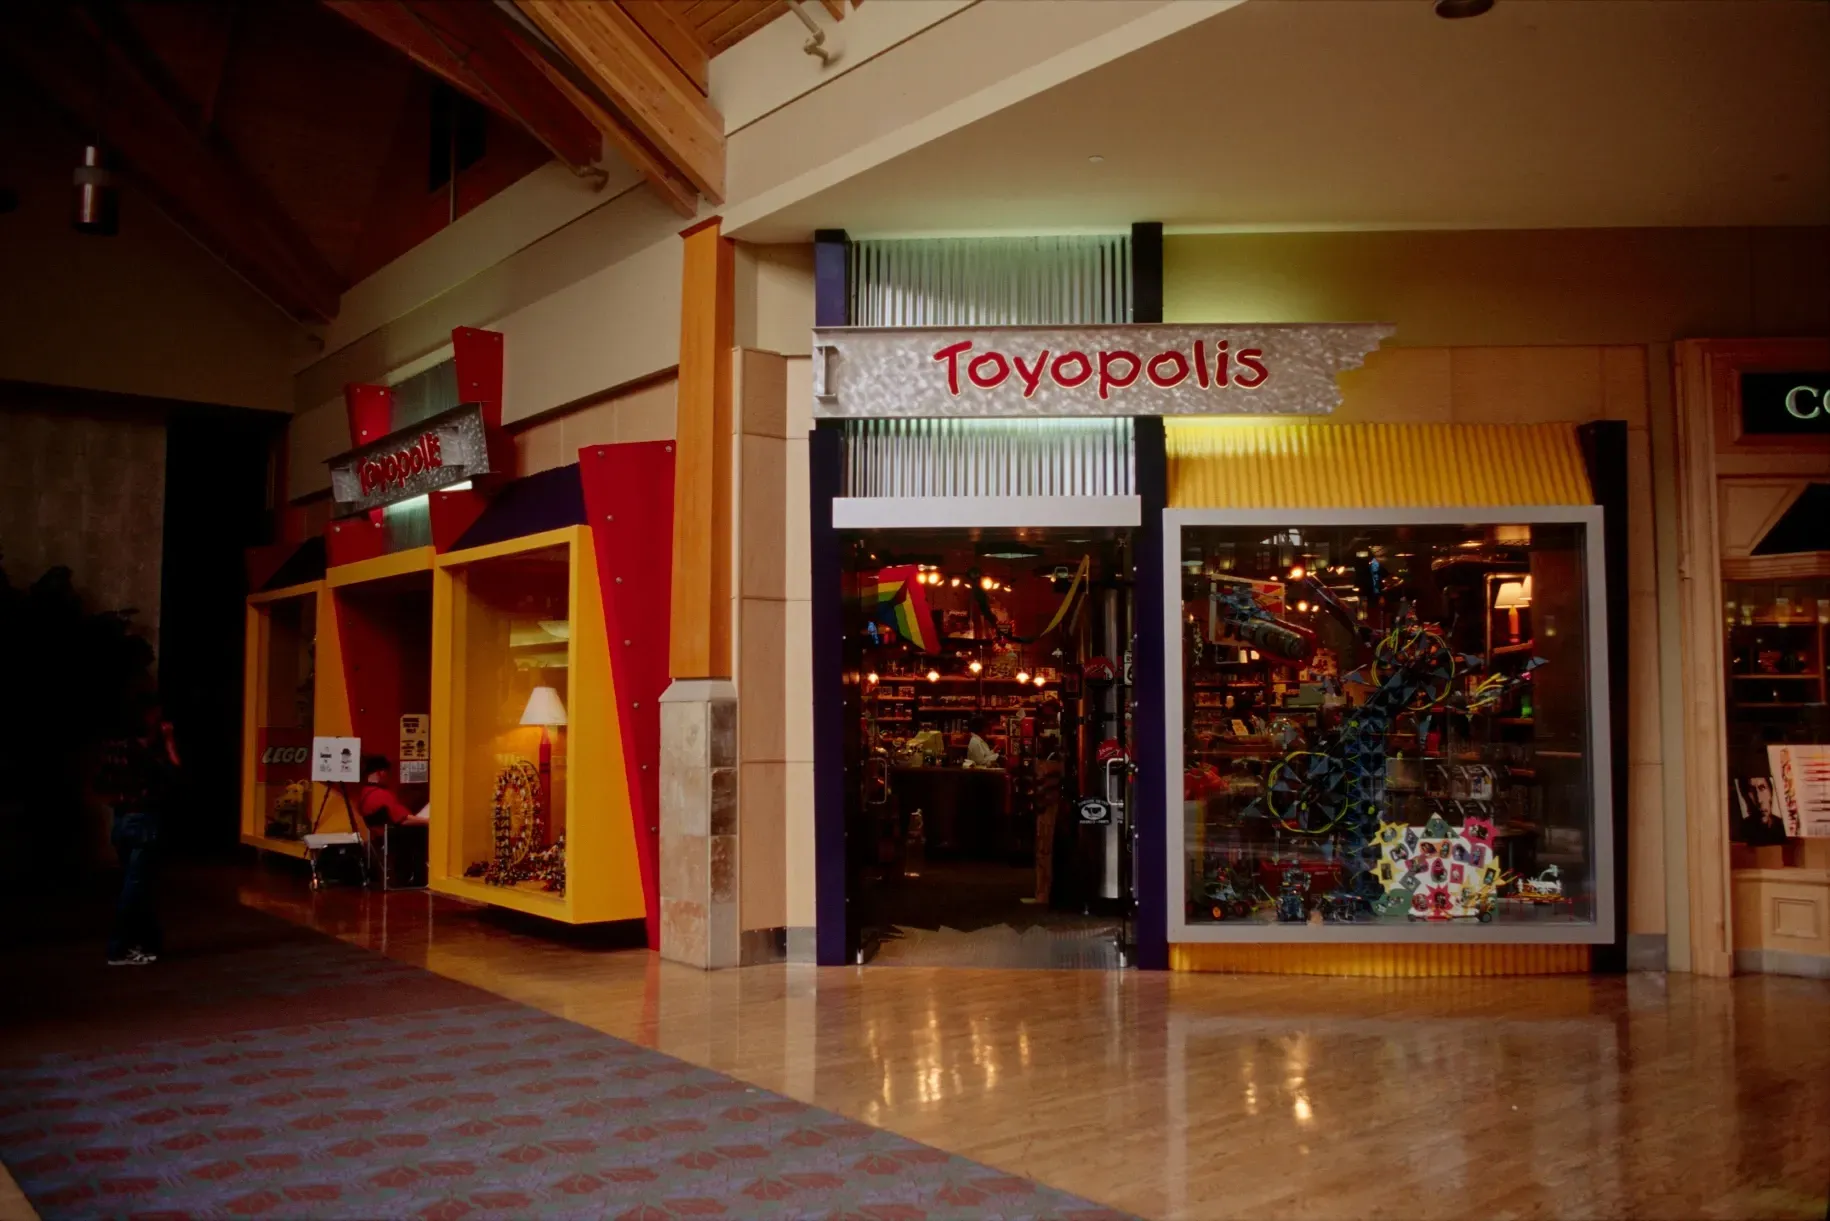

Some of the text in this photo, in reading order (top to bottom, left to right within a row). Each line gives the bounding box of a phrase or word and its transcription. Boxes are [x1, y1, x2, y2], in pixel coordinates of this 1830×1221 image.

[932, 339, 1270, 400] Toyopolis
[1784, 385, 1830, 420] C
[261, 746, 308, 764] LEGO
